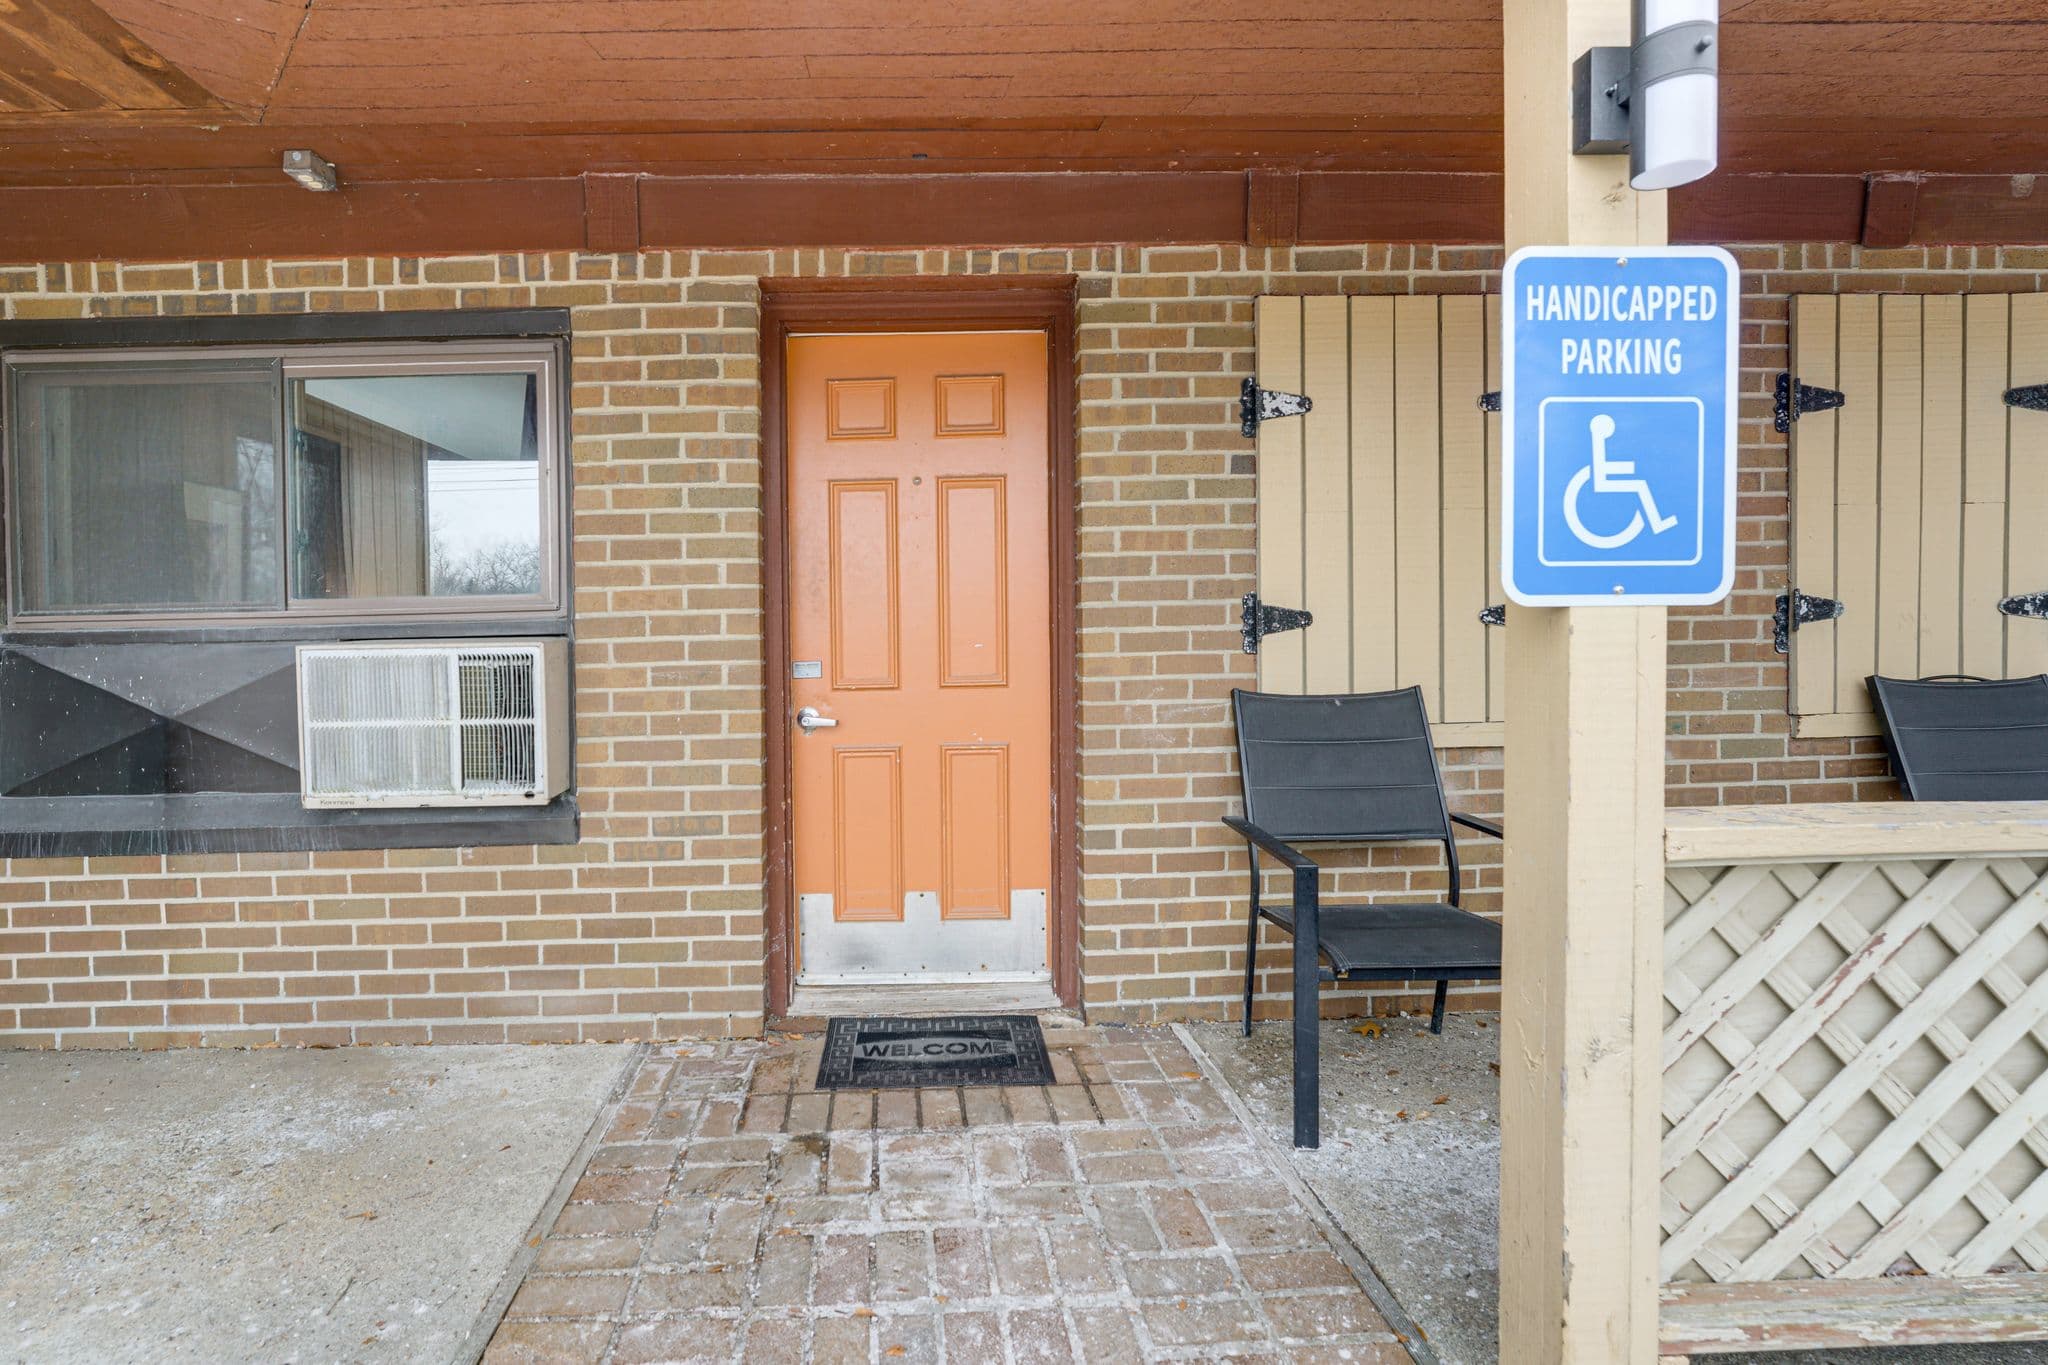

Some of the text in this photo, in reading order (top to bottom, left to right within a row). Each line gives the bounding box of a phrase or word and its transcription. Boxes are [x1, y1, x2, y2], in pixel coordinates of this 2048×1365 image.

[1526, 285, 1717, 321] HANDICAPPED
[1561, 338, 1682, 375] PARKING
[862, 1041, 1009, 1057] WELCOME
